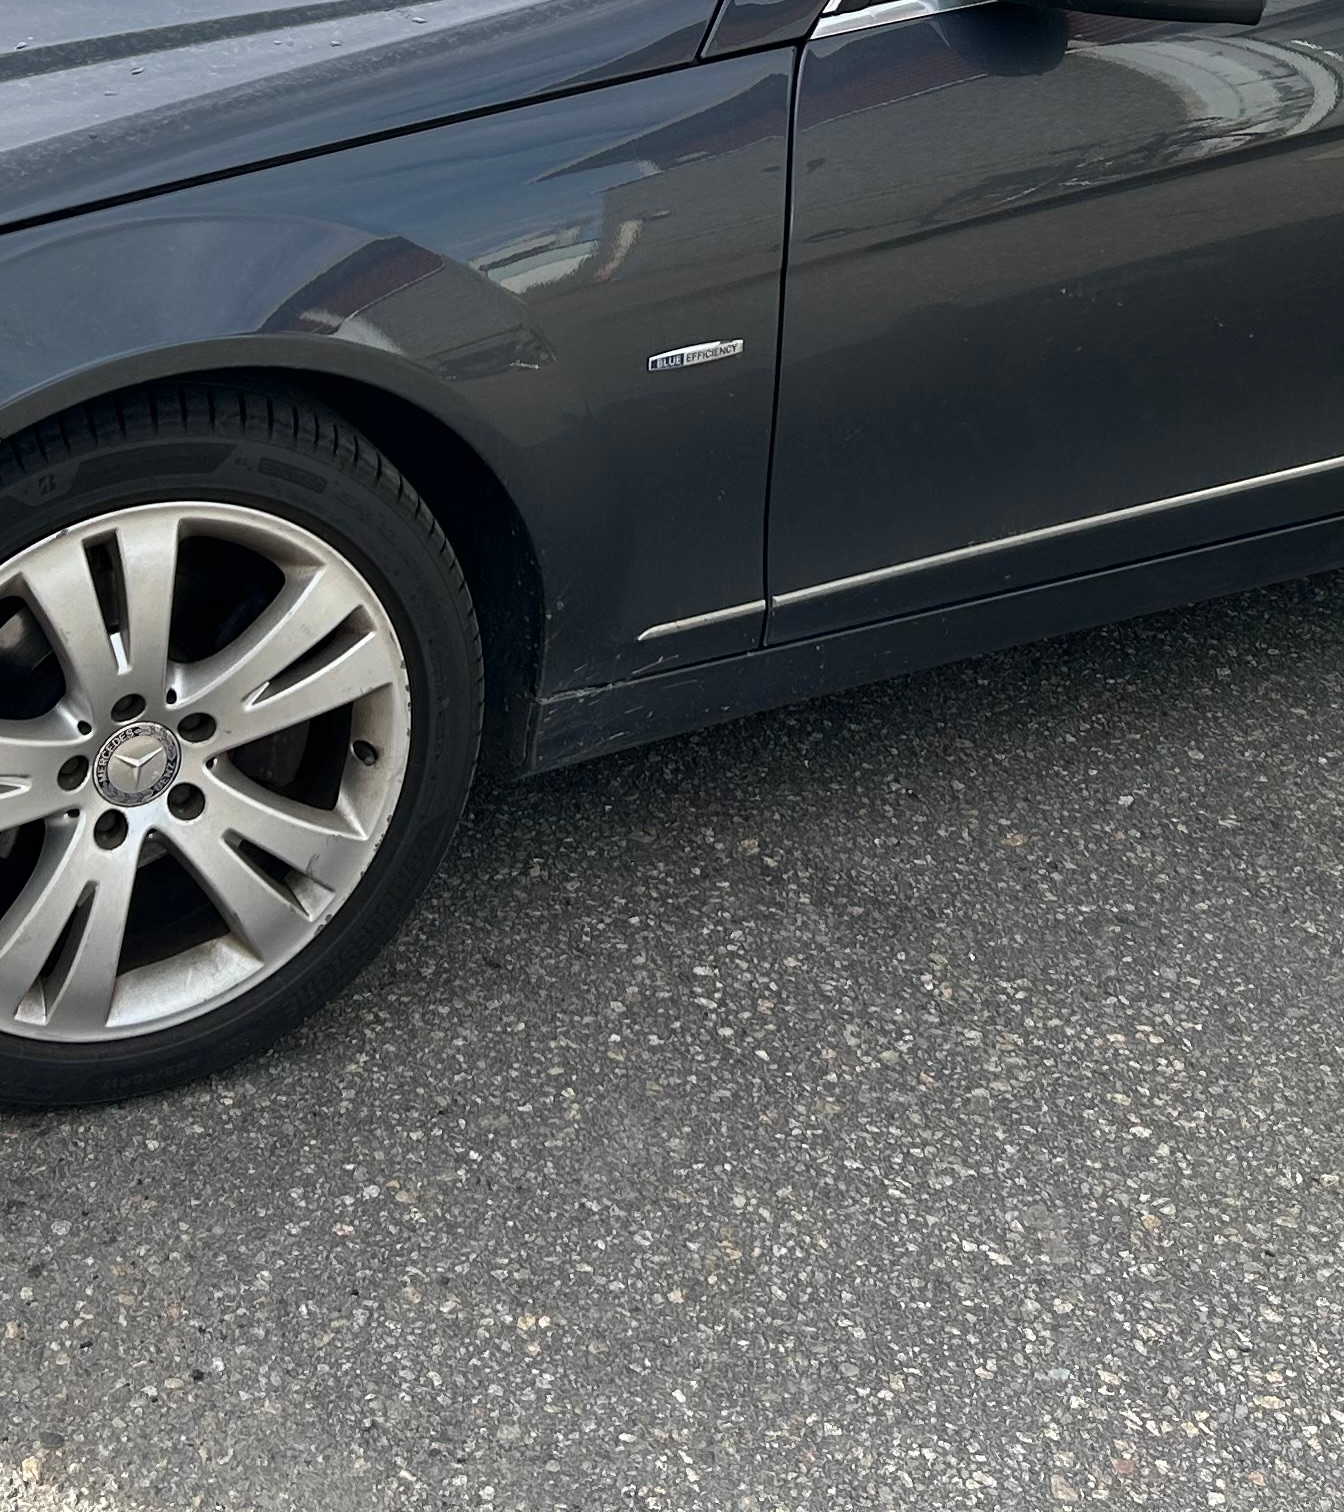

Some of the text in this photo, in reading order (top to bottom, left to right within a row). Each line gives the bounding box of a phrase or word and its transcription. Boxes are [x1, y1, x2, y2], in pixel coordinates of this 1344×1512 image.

[657, 344, 738, 368] BLUE EFFICIENCY
[97, 728, 176, 792] MERCEDES BENZ
